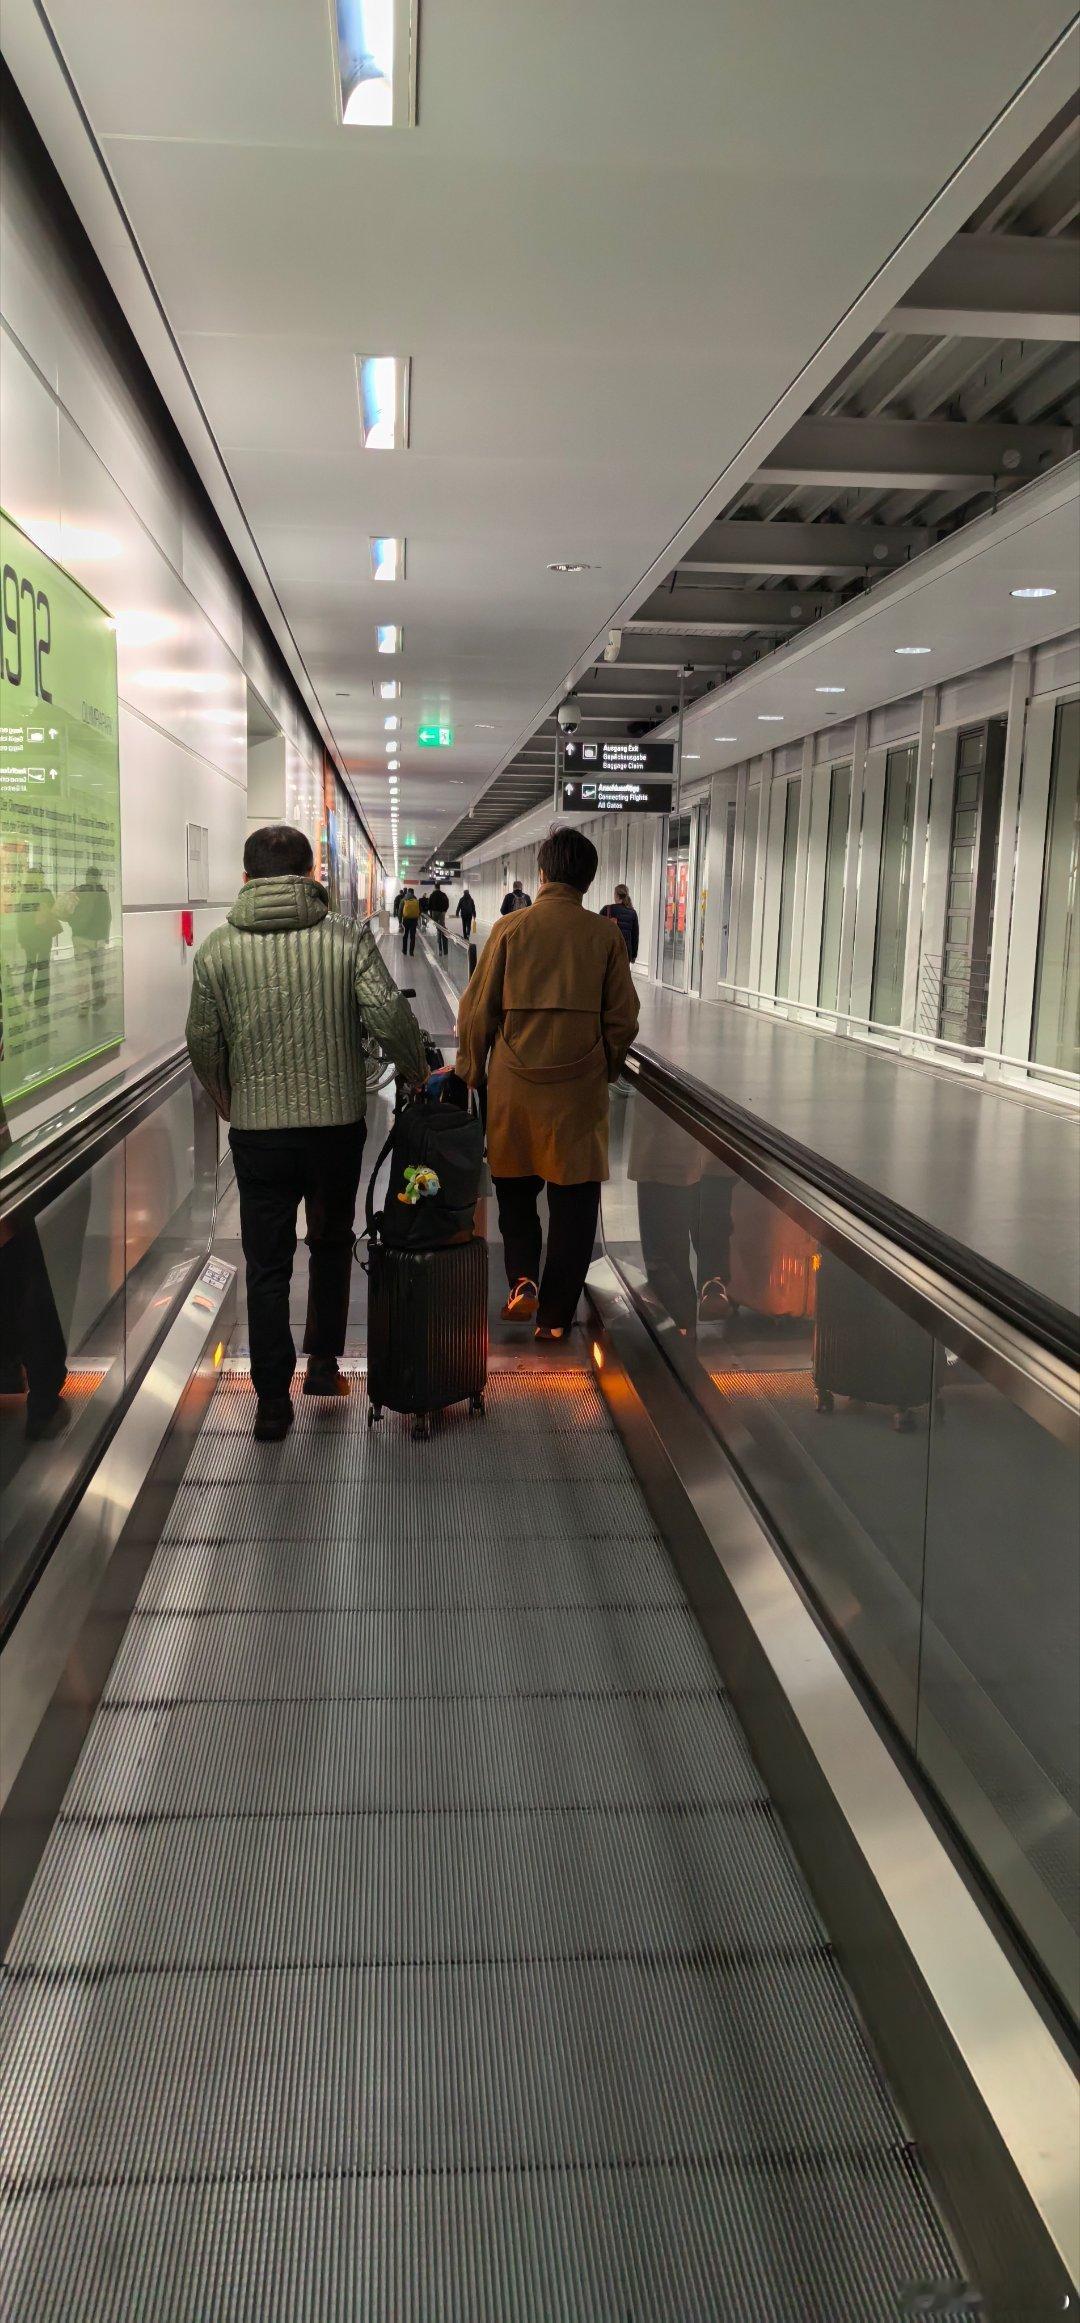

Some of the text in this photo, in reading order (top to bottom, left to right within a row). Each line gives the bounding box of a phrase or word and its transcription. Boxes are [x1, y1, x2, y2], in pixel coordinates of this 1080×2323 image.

[603, 744, 639, 753] Ausgang Exit
[602, 762, 643, 770] Baggage Claim
[598, 793, 648, 802] Connecting Flights
